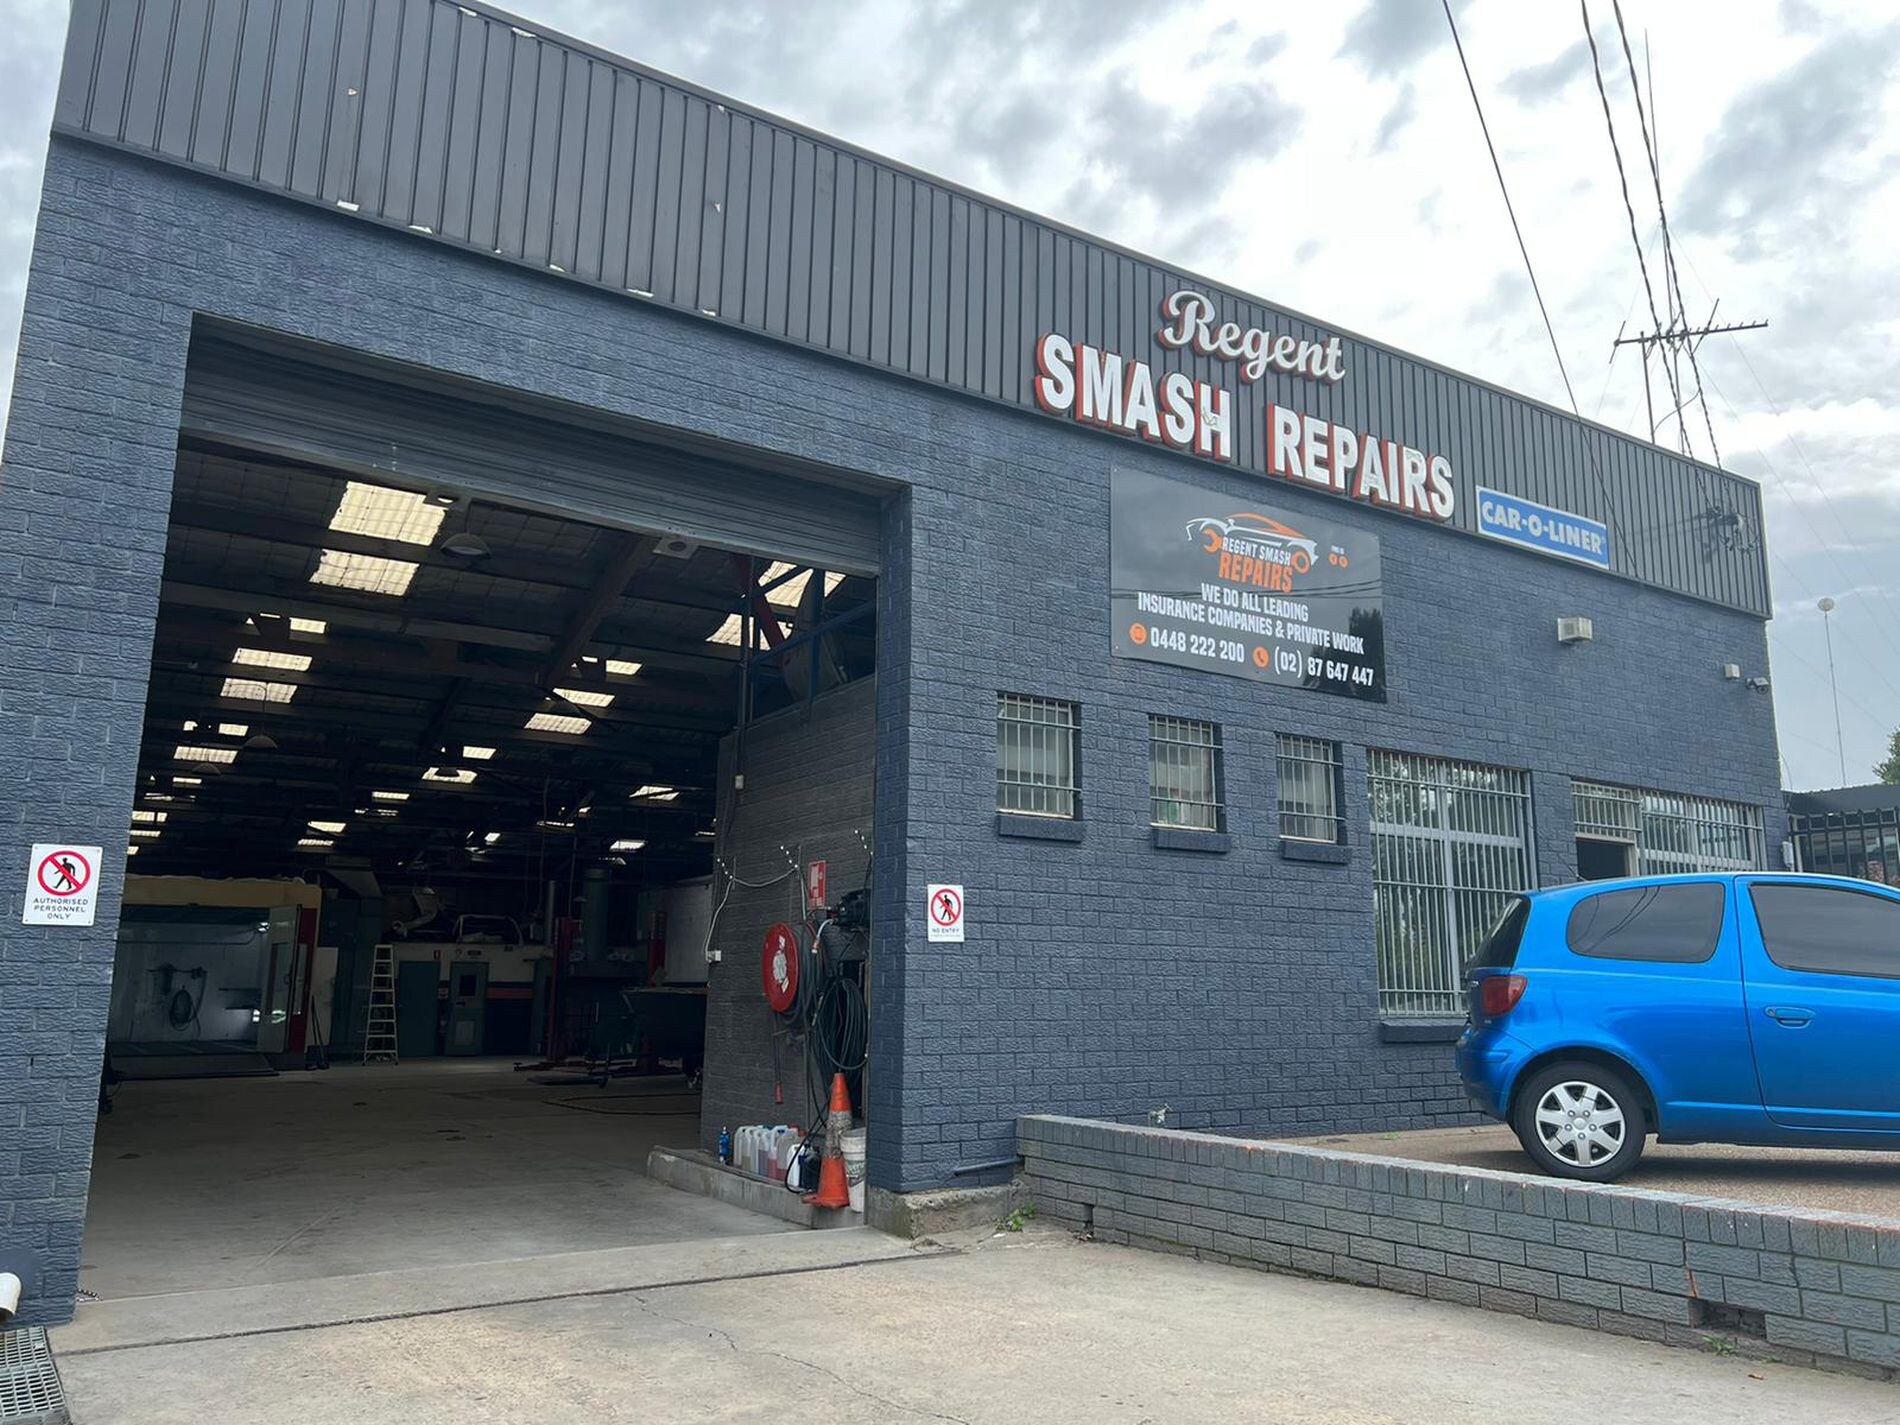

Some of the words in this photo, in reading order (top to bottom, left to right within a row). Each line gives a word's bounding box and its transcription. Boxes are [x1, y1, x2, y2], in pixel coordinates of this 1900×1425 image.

[1160, 290, 1347, 385] Regent
[1036, 332, 1232, 462] SMASH
[1267, 402, 1455, 522] REPAIRS
[1481, 500, 1603, 555] CAR-O-LINER
[1218, 550, 1293, 593] REPAIRS
[1221, 536, 1258, 558] REGENT
[1258, 545, 1292, 567] SMASH
[1137, 591, 1205, 623] INSURANCE
[1207, 605, 1273, 637] COMPANIES
[1275, 620, 1285, 639] &
[1286, 622, 1331, 648] PRIVATE
[1331, 631, 1365, 655] WORK
[1201, 582, 1221, 604] WE
[1222, 587, 1239, 608] DO
[1241, 591, 1262, 613] ALL
[1263, 596, 1309, 623] LEADING
[1150, 626, 1187, 653] 0448
[1189, 634, 1217, 659] 222
[1219, 639, 1245, 664] 200
[1274, 645, 1303, 679] (02)
[1307, 656, 1324, 678] 87
[1326, 660, 1350, 683] 647
[1351, 665, 1375, 687] 447
